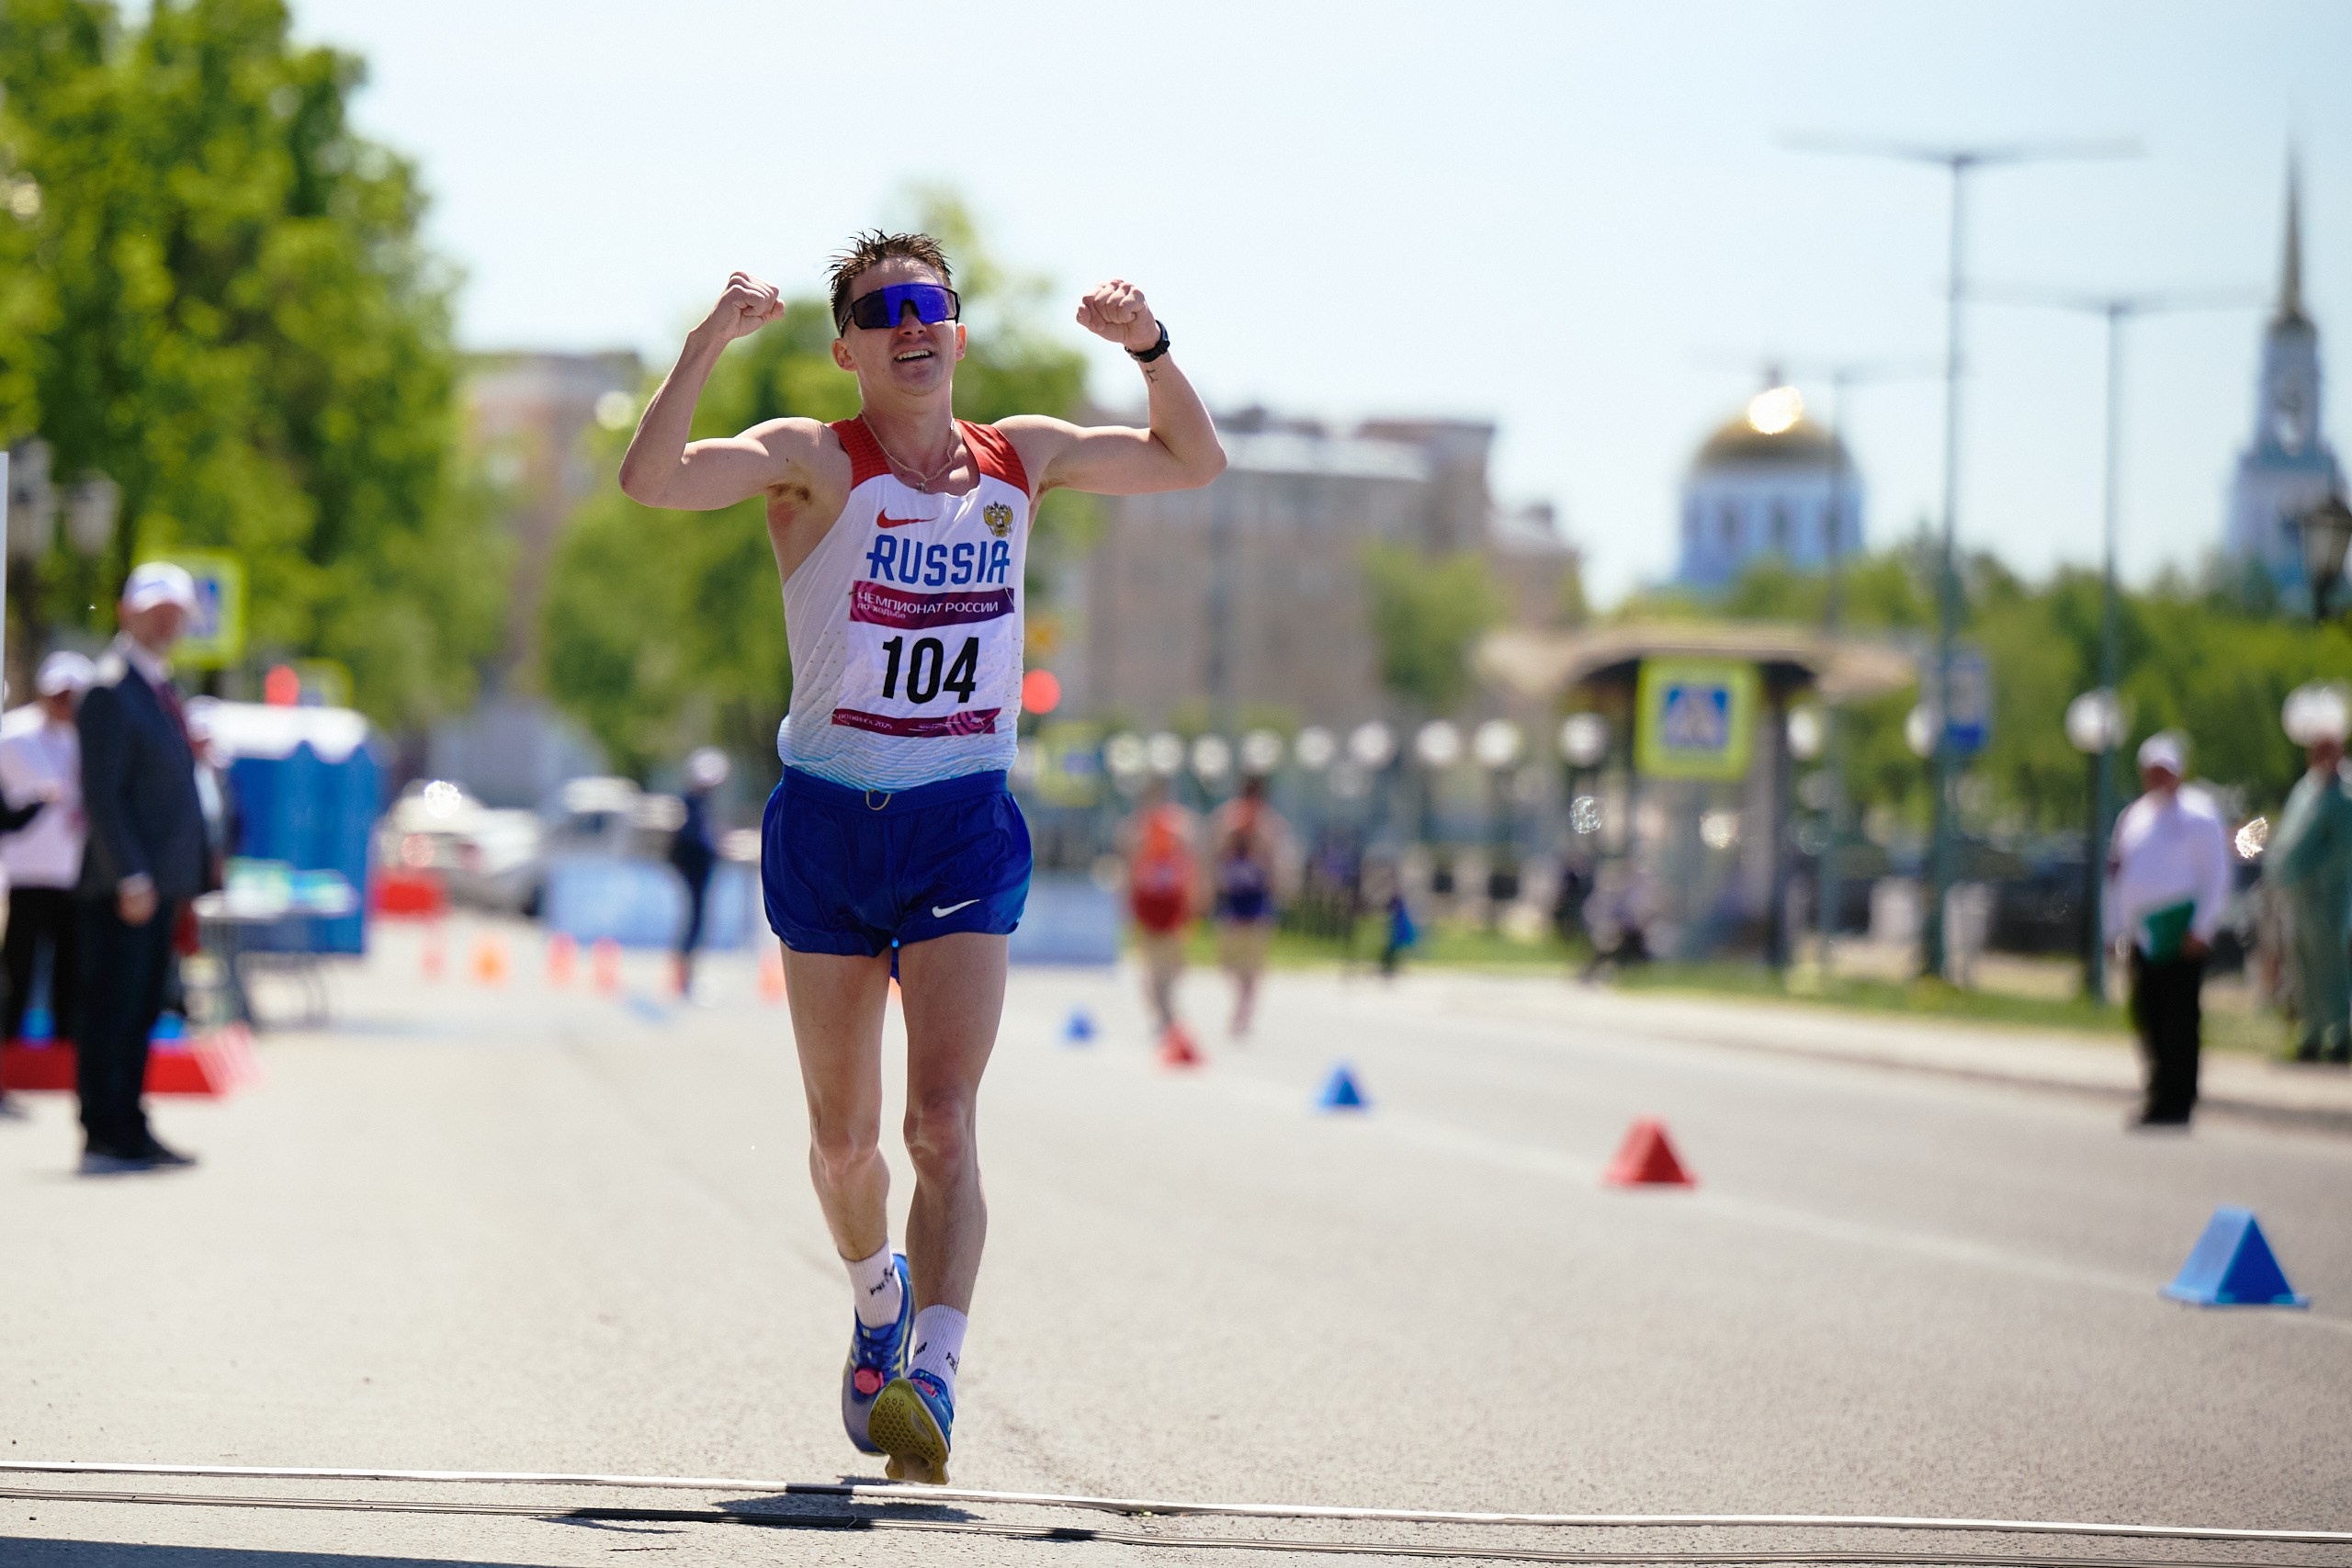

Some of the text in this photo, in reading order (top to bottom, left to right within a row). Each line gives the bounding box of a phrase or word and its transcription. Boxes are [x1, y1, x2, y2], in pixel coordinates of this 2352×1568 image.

[866, 534, 1011, 587] RUSSIA
[857, 592, 999, 614] ЧЕМПИОНАТ РОССИИ
[882, 635, 979, 705] 104
